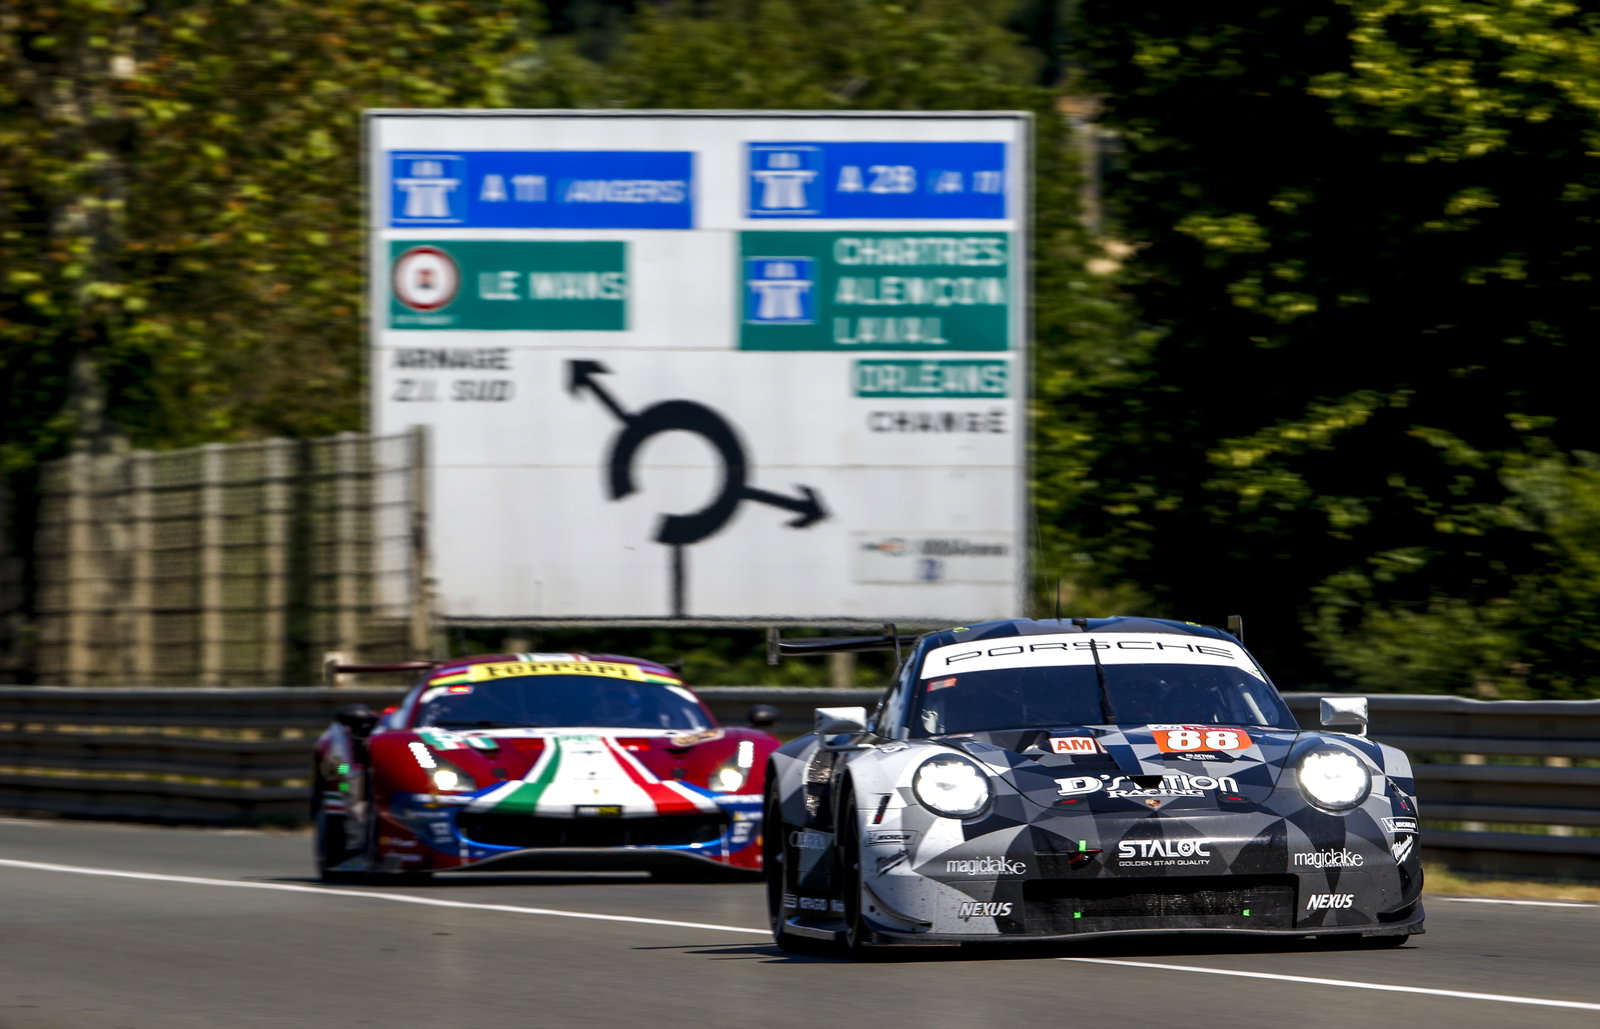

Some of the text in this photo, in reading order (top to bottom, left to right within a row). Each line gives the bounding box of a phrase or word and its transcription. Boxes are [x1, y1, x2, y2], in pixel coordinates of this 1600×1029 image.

[480, 174, 507, 201] A
[837, 165, 864, 193] A
[479, 271, 624, 300] LE MANS
[946, 641, 1235, 666] PORSCHE
[1057, 739, 1094, 751] AM
[1166, 730, 1241, 751] 88
[1118, 839, 1211, 858] STALOC
[1294, 848, 1364, 869] magiclake
[946, 856, 1027, 876] magiclake
[959, 902, 1014, 917] NEXUS
[1306, 894, 1355, 910] NEXUS
